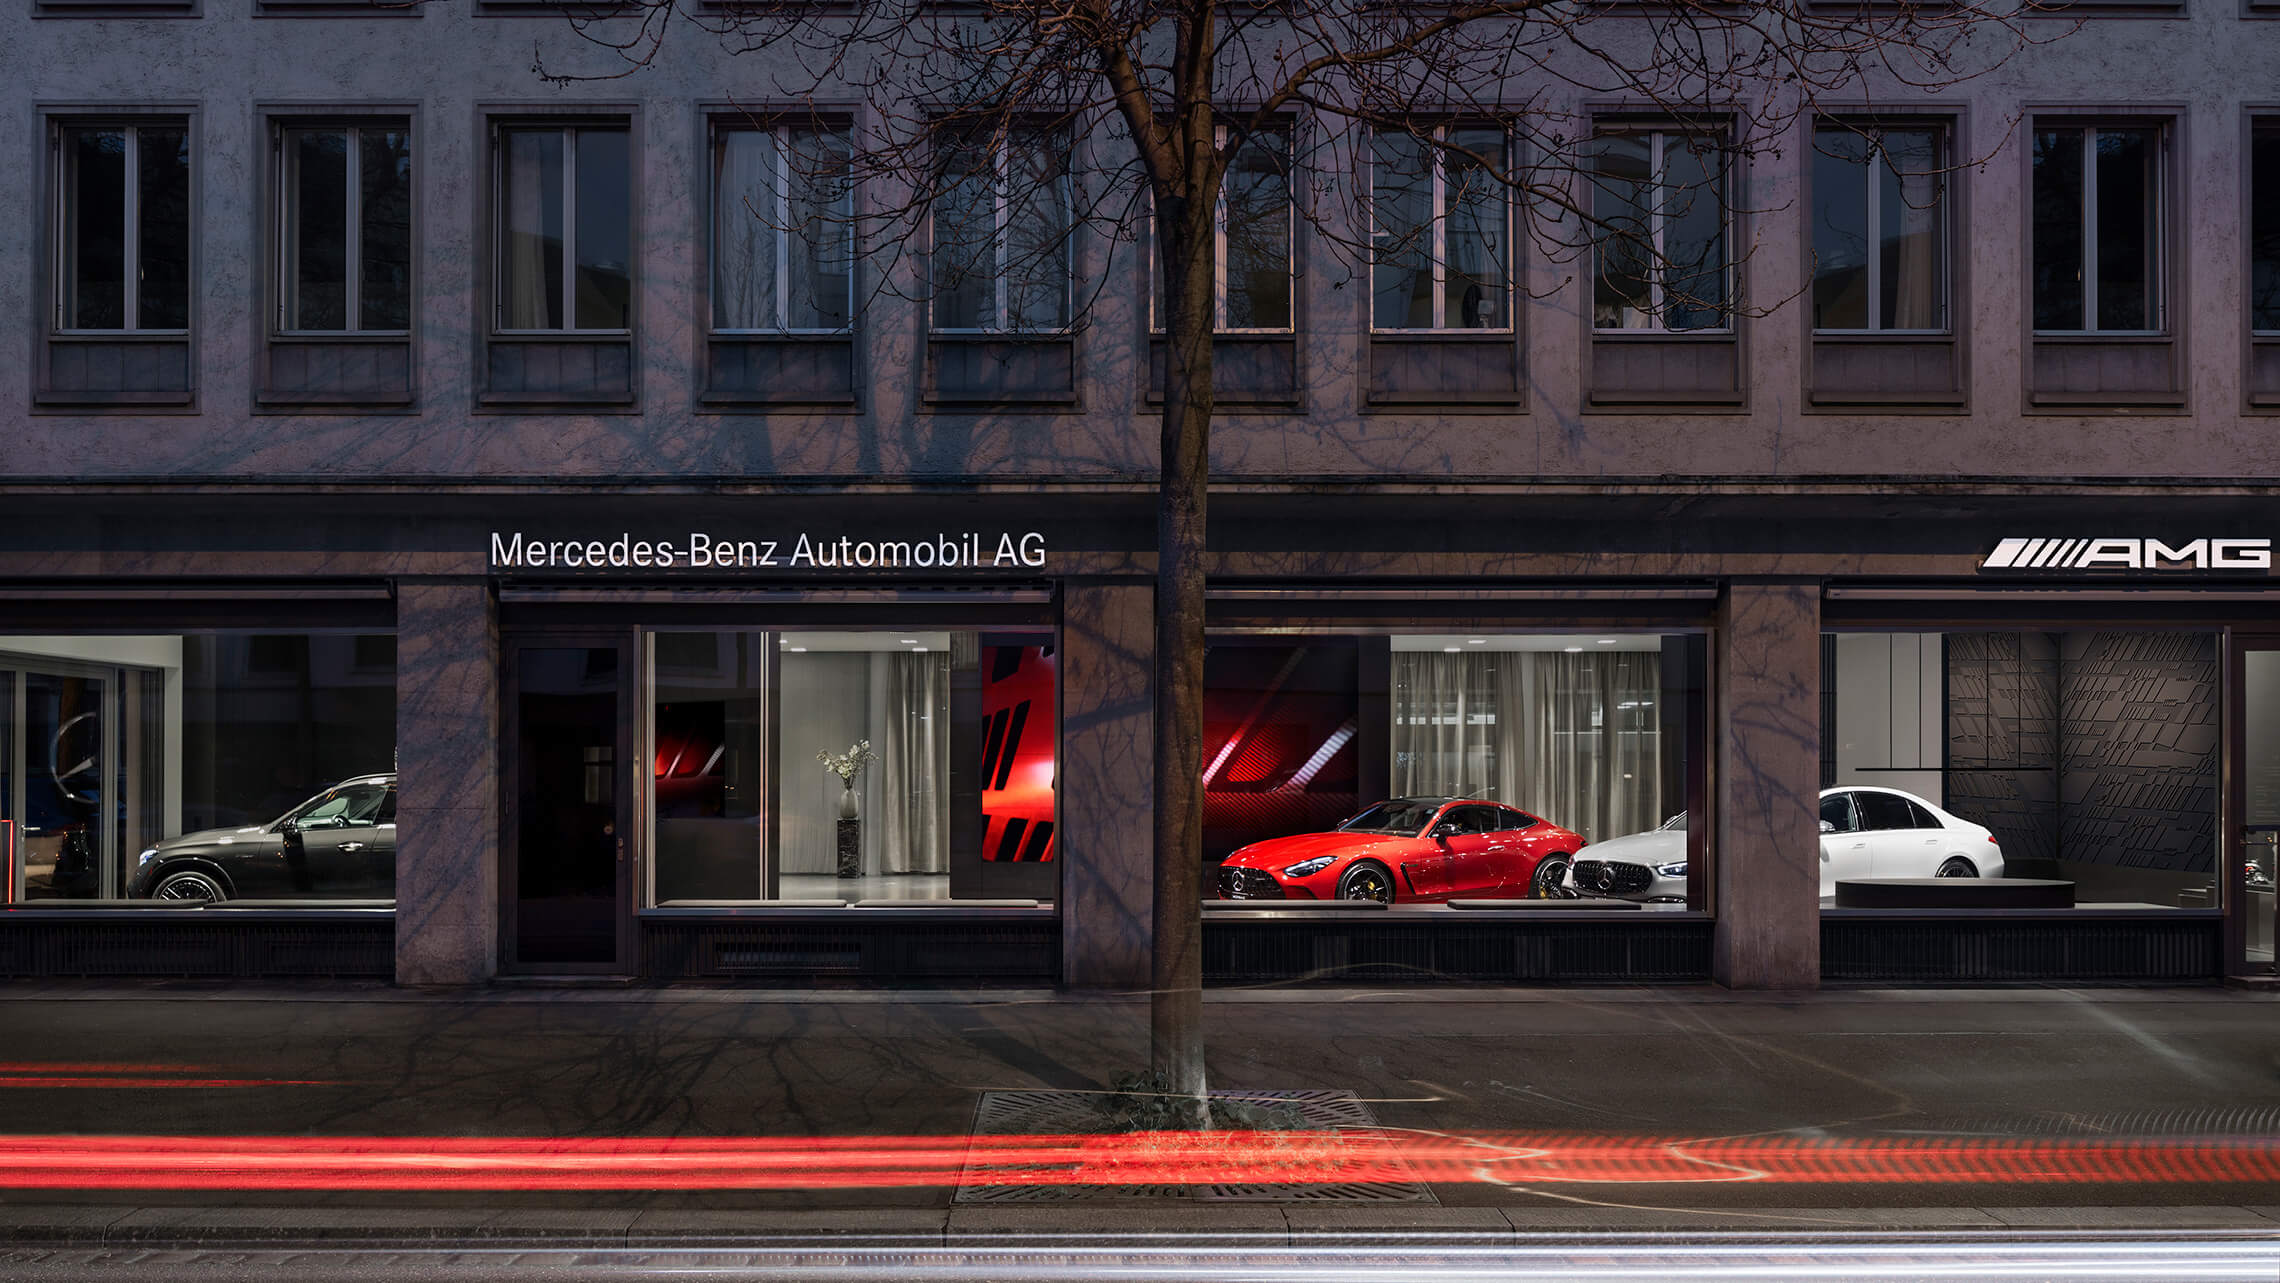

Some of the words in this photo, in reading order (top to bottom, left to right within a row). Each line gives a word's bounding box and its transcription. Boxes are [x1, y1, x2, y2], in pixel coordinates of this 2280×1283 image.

[490, 532, 778, 567] Mercedes-Benz
[789, 532, 979, 567] Automobil
[992, 532, 1047, 567] AG
[2074, 537, 2271, 568] AMG
